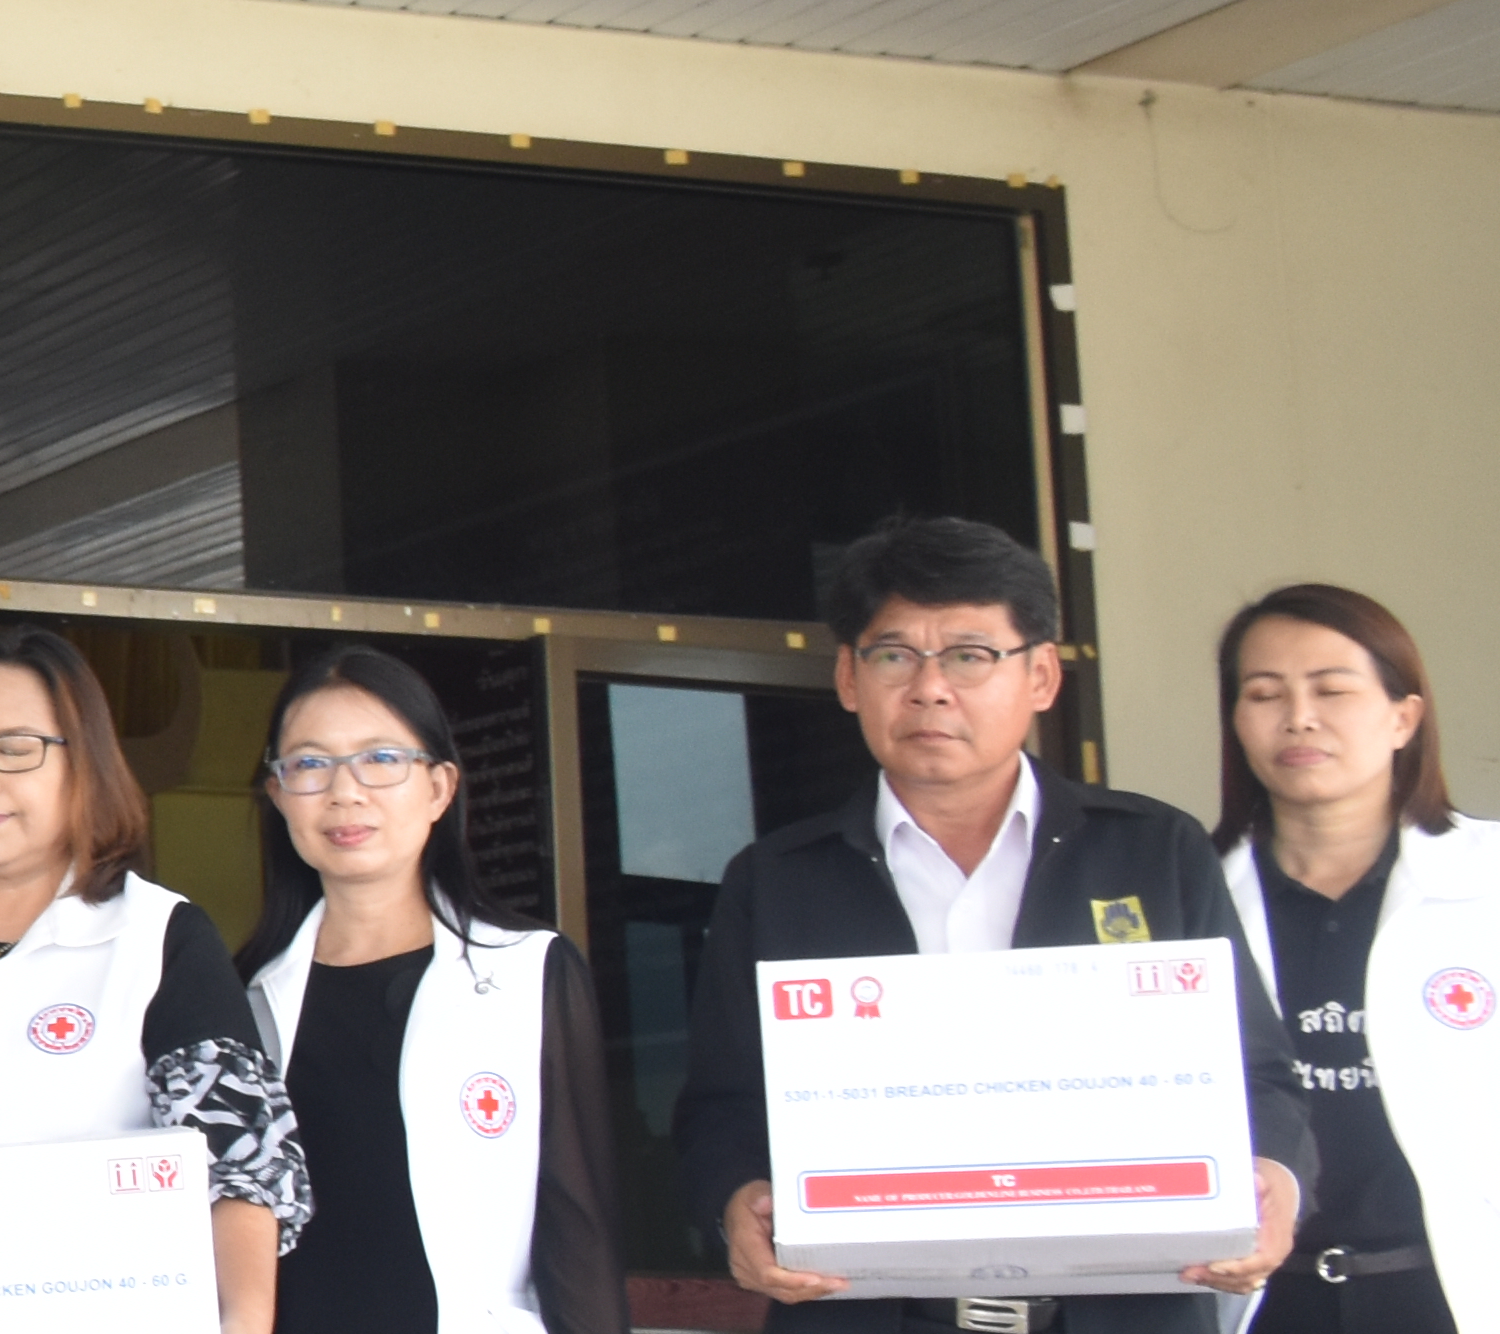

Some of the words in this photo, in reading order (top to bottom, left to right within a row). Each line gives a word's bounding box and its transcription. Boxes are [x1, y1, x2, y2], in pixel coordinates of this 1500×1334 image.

[781, 982, 824, 1017] TC
[783, 1087, 878, 1103] 5301-1-5031
[883, 1081, 968, 1099] BREADED
[973, 1078, 1052, 1094] CHICKEN
[1057, 1075, 1134, 1091] GOUJON
[1138, 1074, 1158, 1087] 40
[1174, 1072, 1194, 1086] 60
[991, 1173, 1017, 1188] TC
[41, 1278, 113, 1295] GOUJON
[118, 1276, 136, 1289] 40
[152, 1274, 170, 1287] 60
